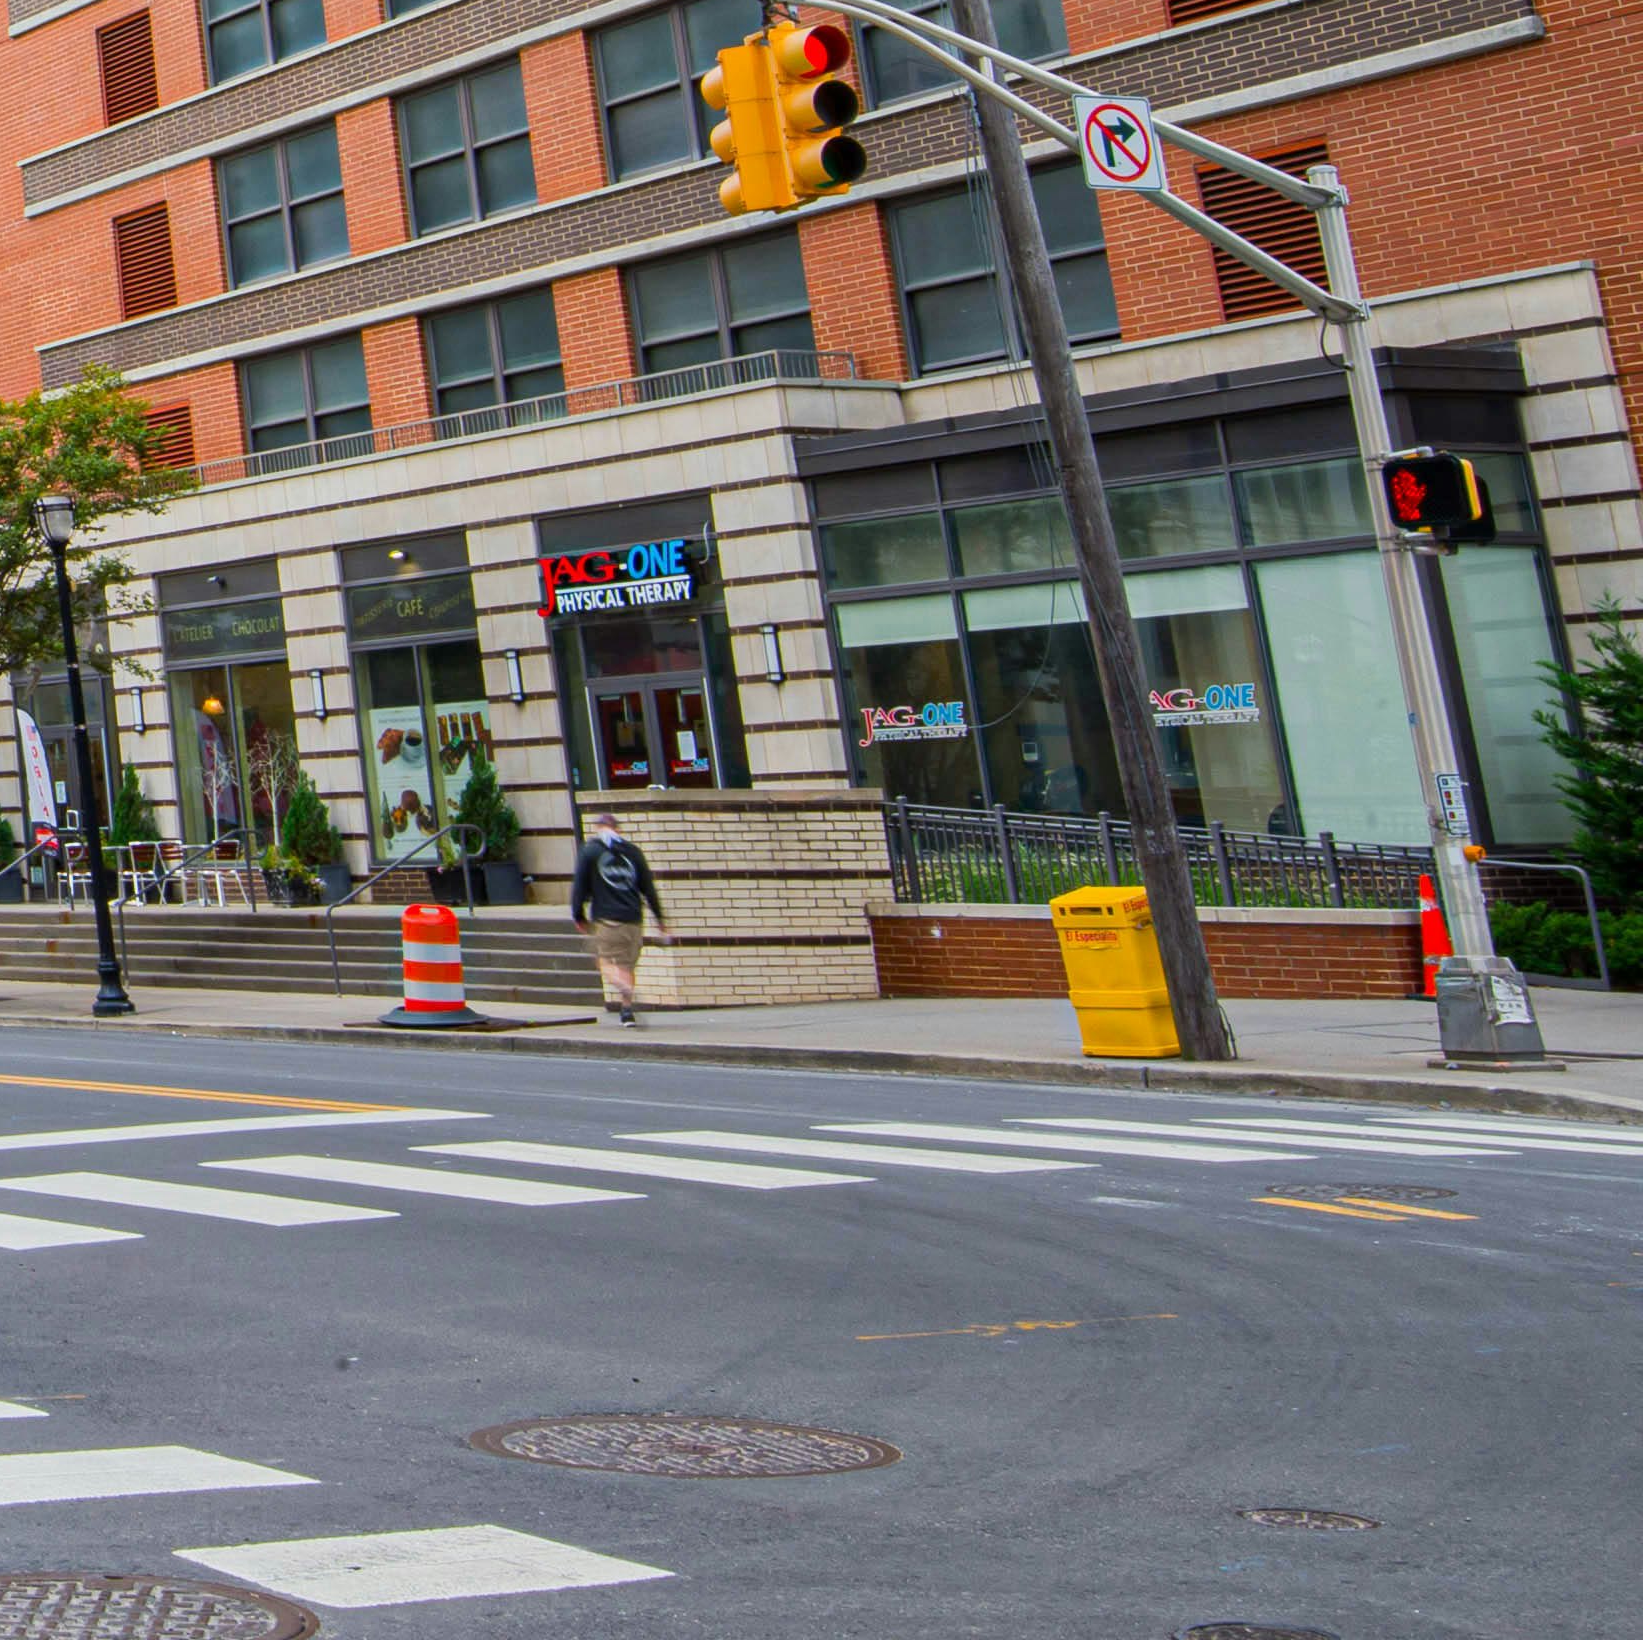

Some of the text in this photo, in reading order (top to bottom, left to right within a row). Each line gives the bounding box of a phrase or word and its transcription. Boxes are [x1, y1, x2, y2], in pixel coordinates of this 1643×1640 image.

[537, 539, 686, 618] JAG-ONE
[557, 580, 691, 614] PHYSICAL THERAPY
[231, 616, 279, 636] CHOCOLAT
[1148, 683, 1255, 711] AG-ONE
[858, 701, 964, 747] JAG-ONE
